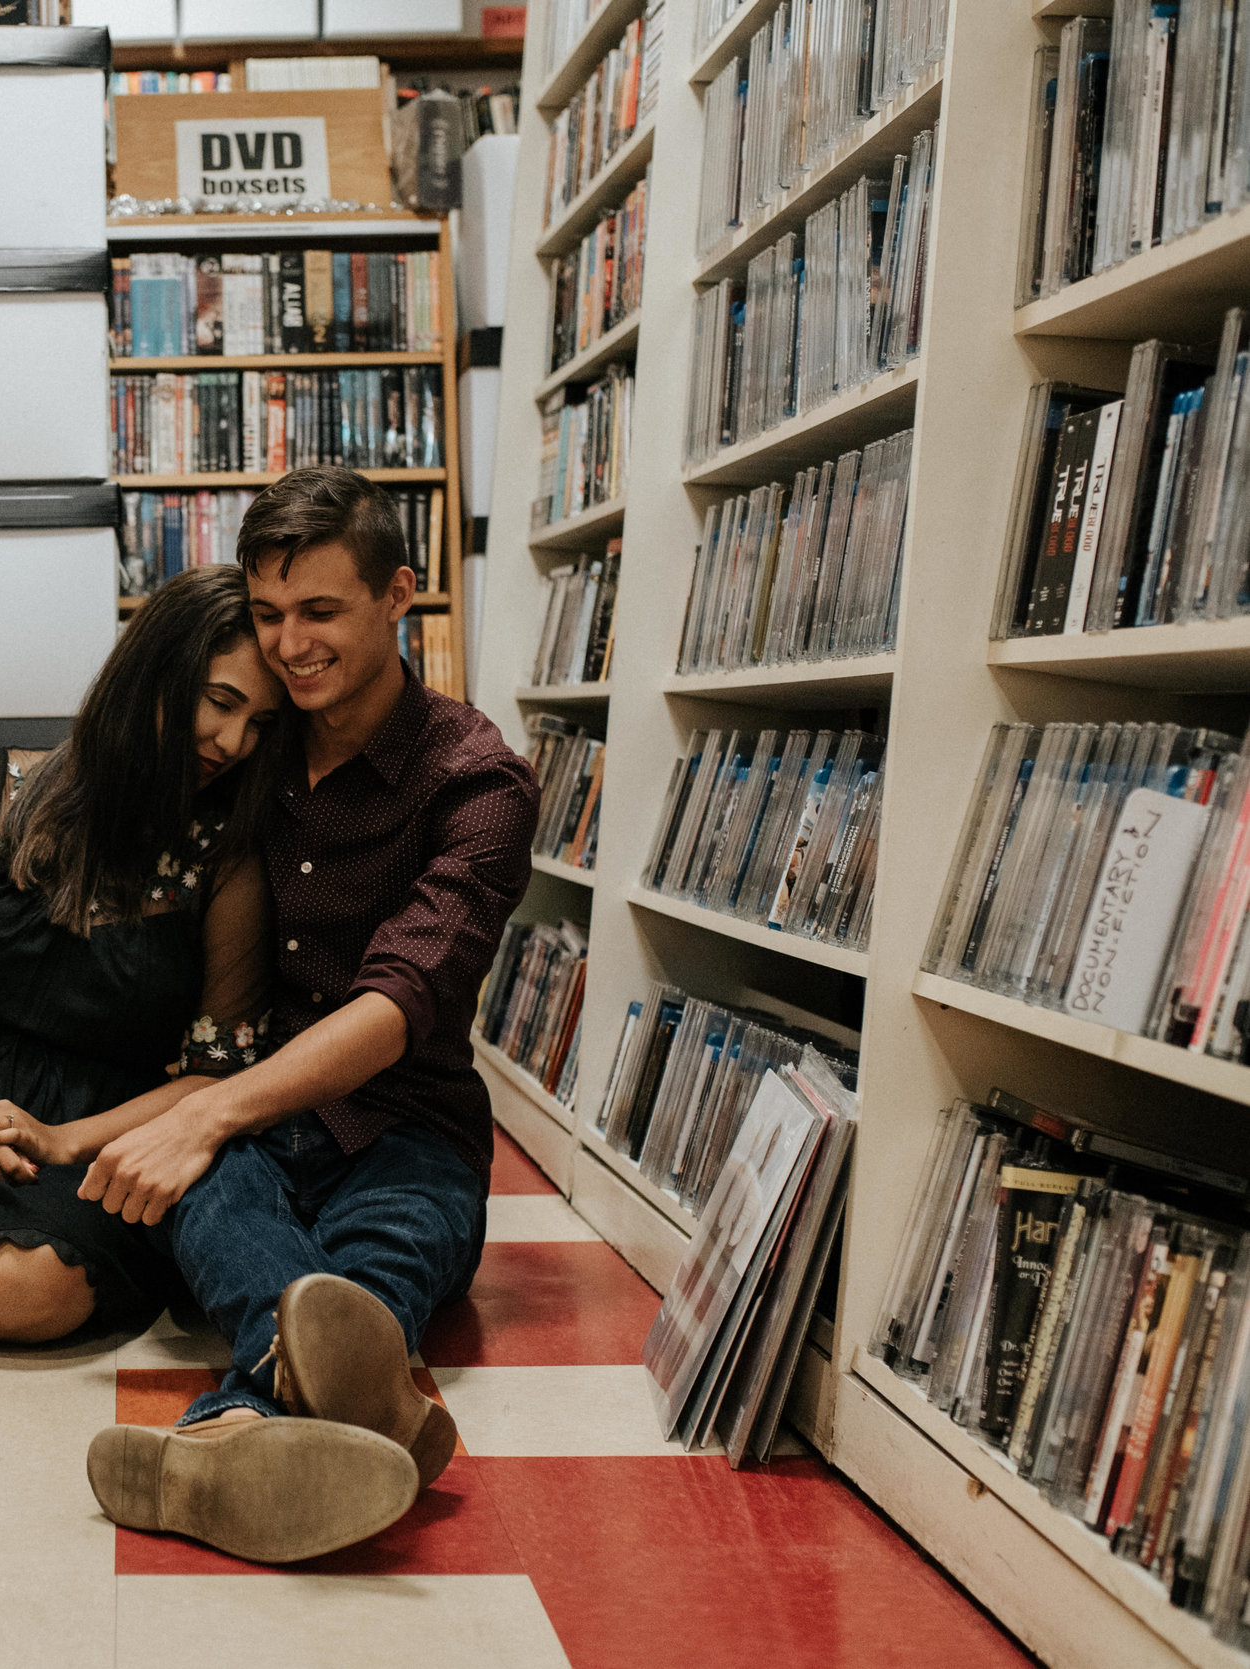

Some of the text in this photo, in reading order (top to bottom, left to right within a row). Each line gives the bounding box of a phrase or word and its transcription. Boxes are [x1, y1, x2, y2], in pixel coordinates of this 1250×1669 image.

[201, 132, 303, 171] DVD
[202, 177, 306, 195] boxsets
[1072, 850, 1129, 1011] DOCUMENTARY
[1093, 810, 1162, 1014] NON-FICTION
